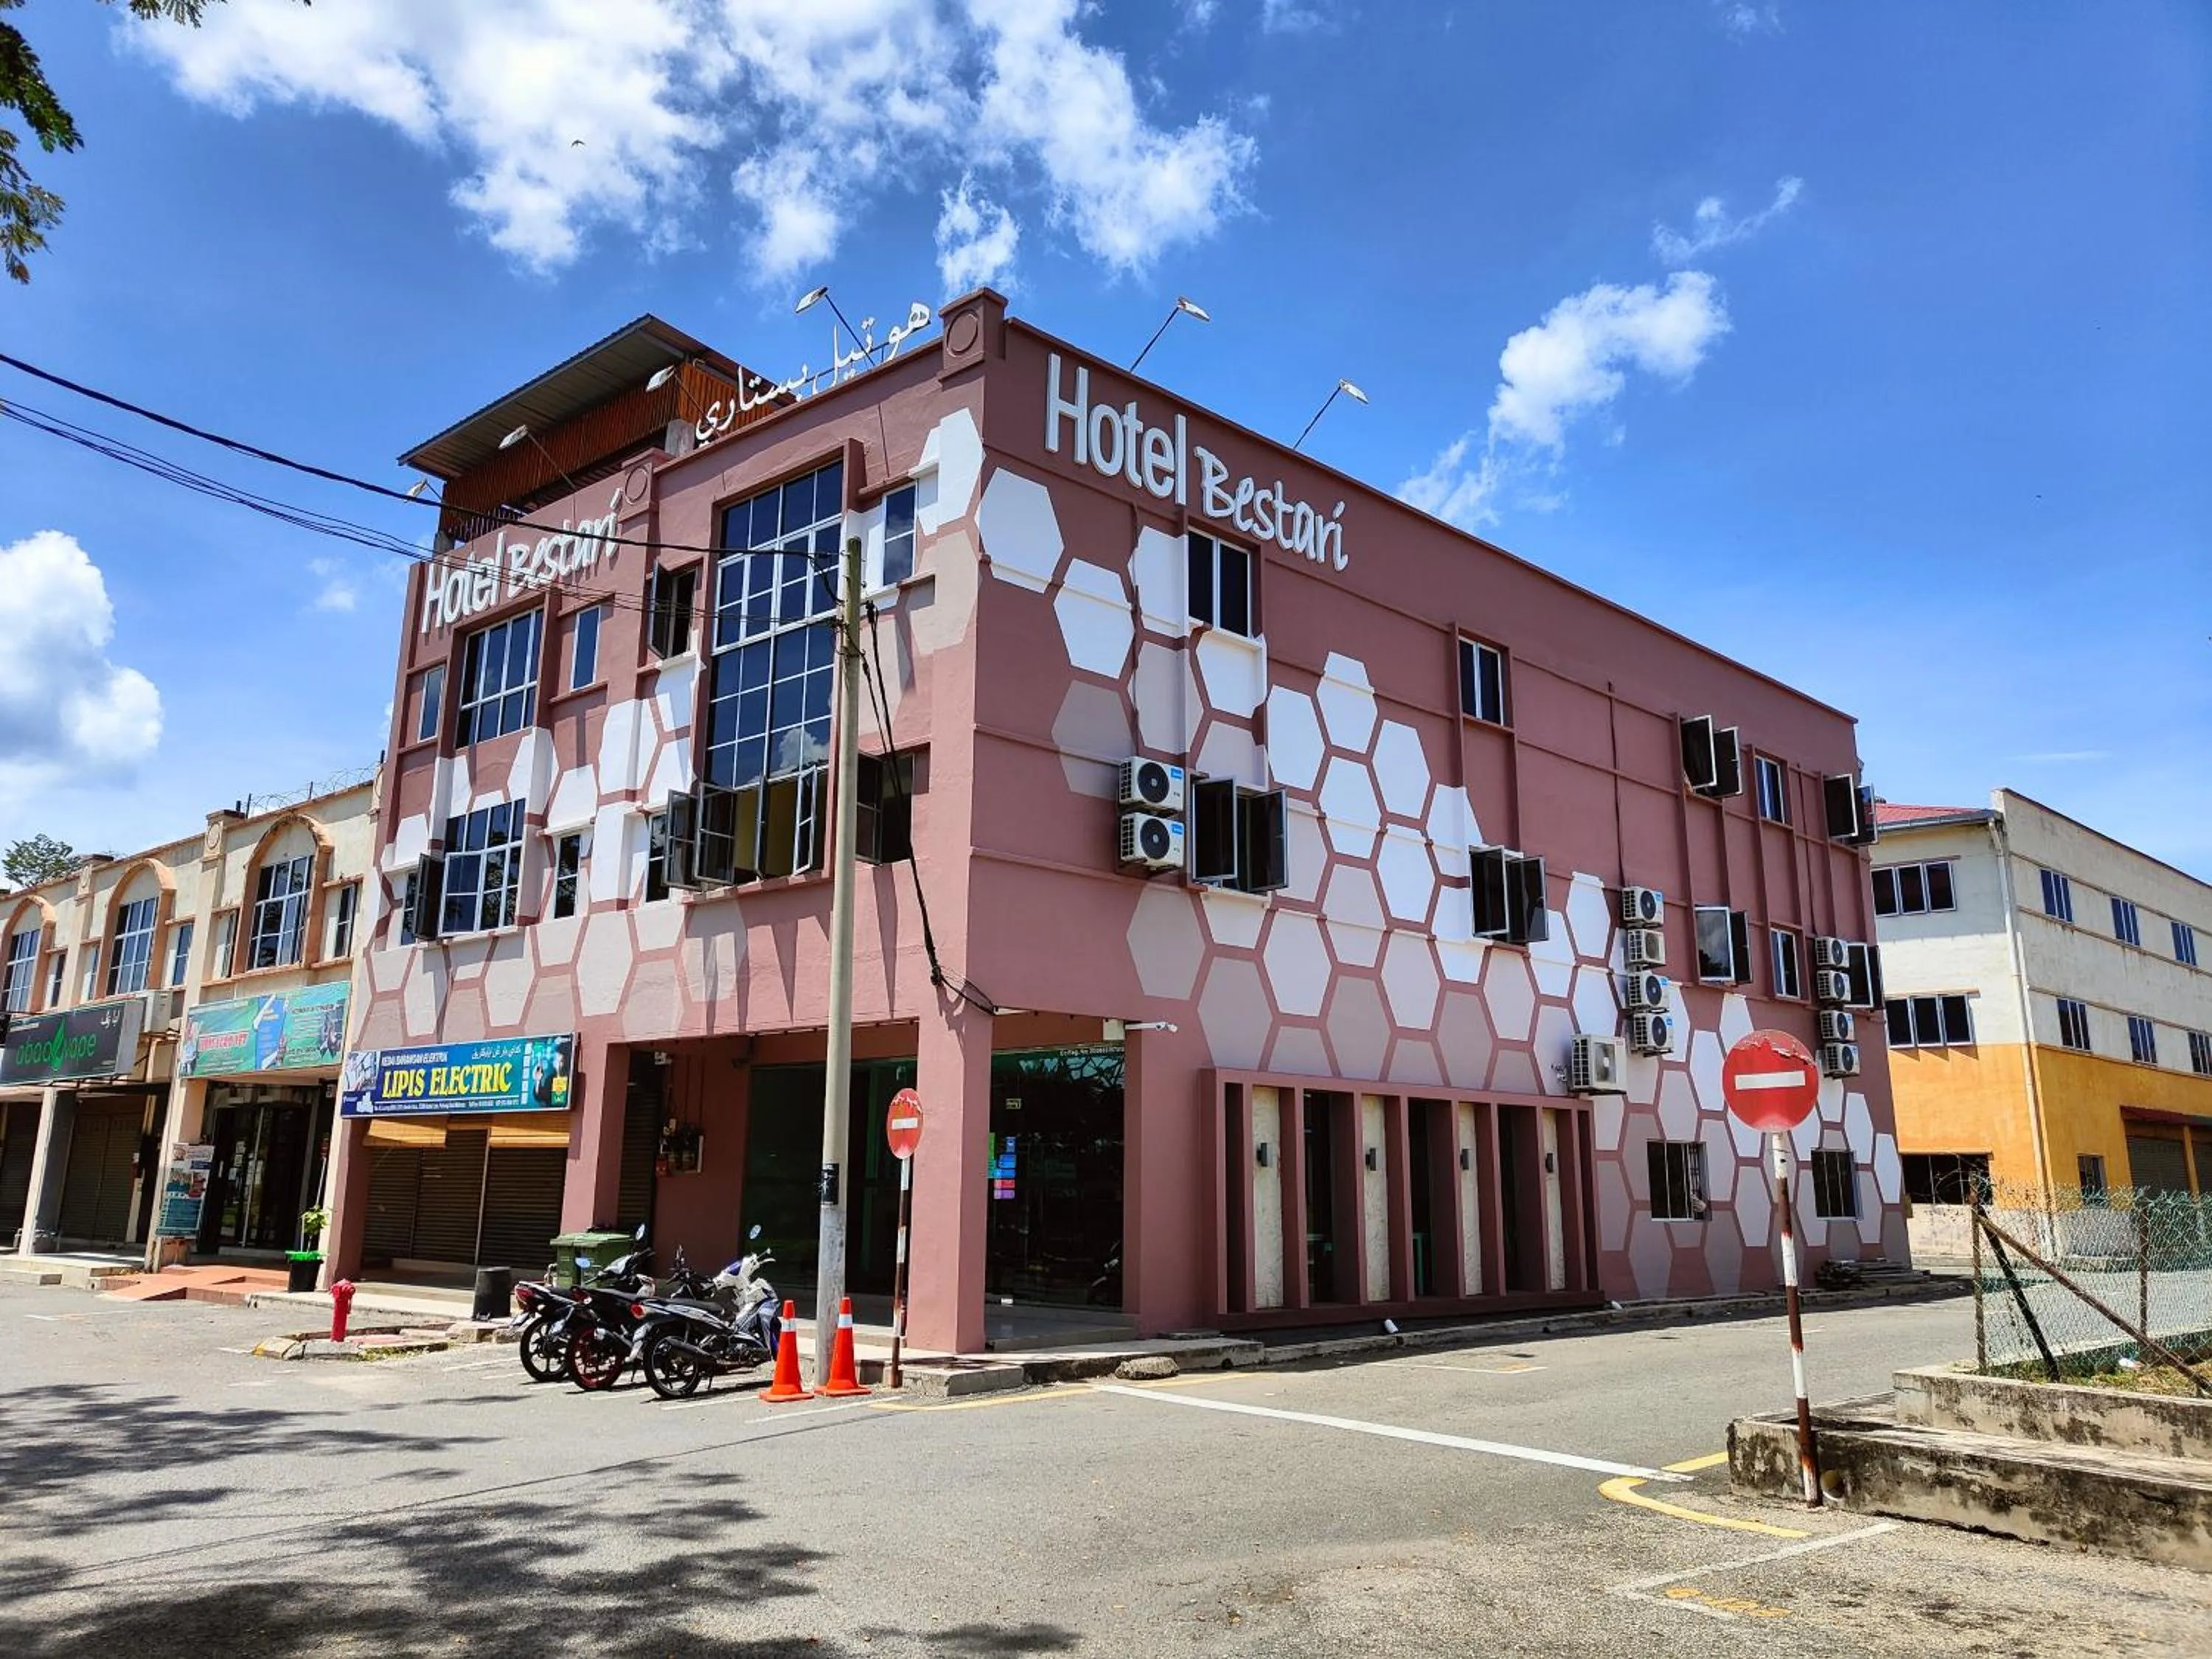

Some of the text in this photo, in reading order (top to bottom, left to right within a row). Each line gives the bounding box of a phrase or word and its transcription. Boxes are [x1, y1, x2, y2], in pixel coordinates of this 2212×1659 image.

[1044, 352, 1349, 572] Hotel Bestari
[421, 487, 624, 634] Hotel Bestari
[382, 1062, 512, 1098] LIPIS ELECTRIC
